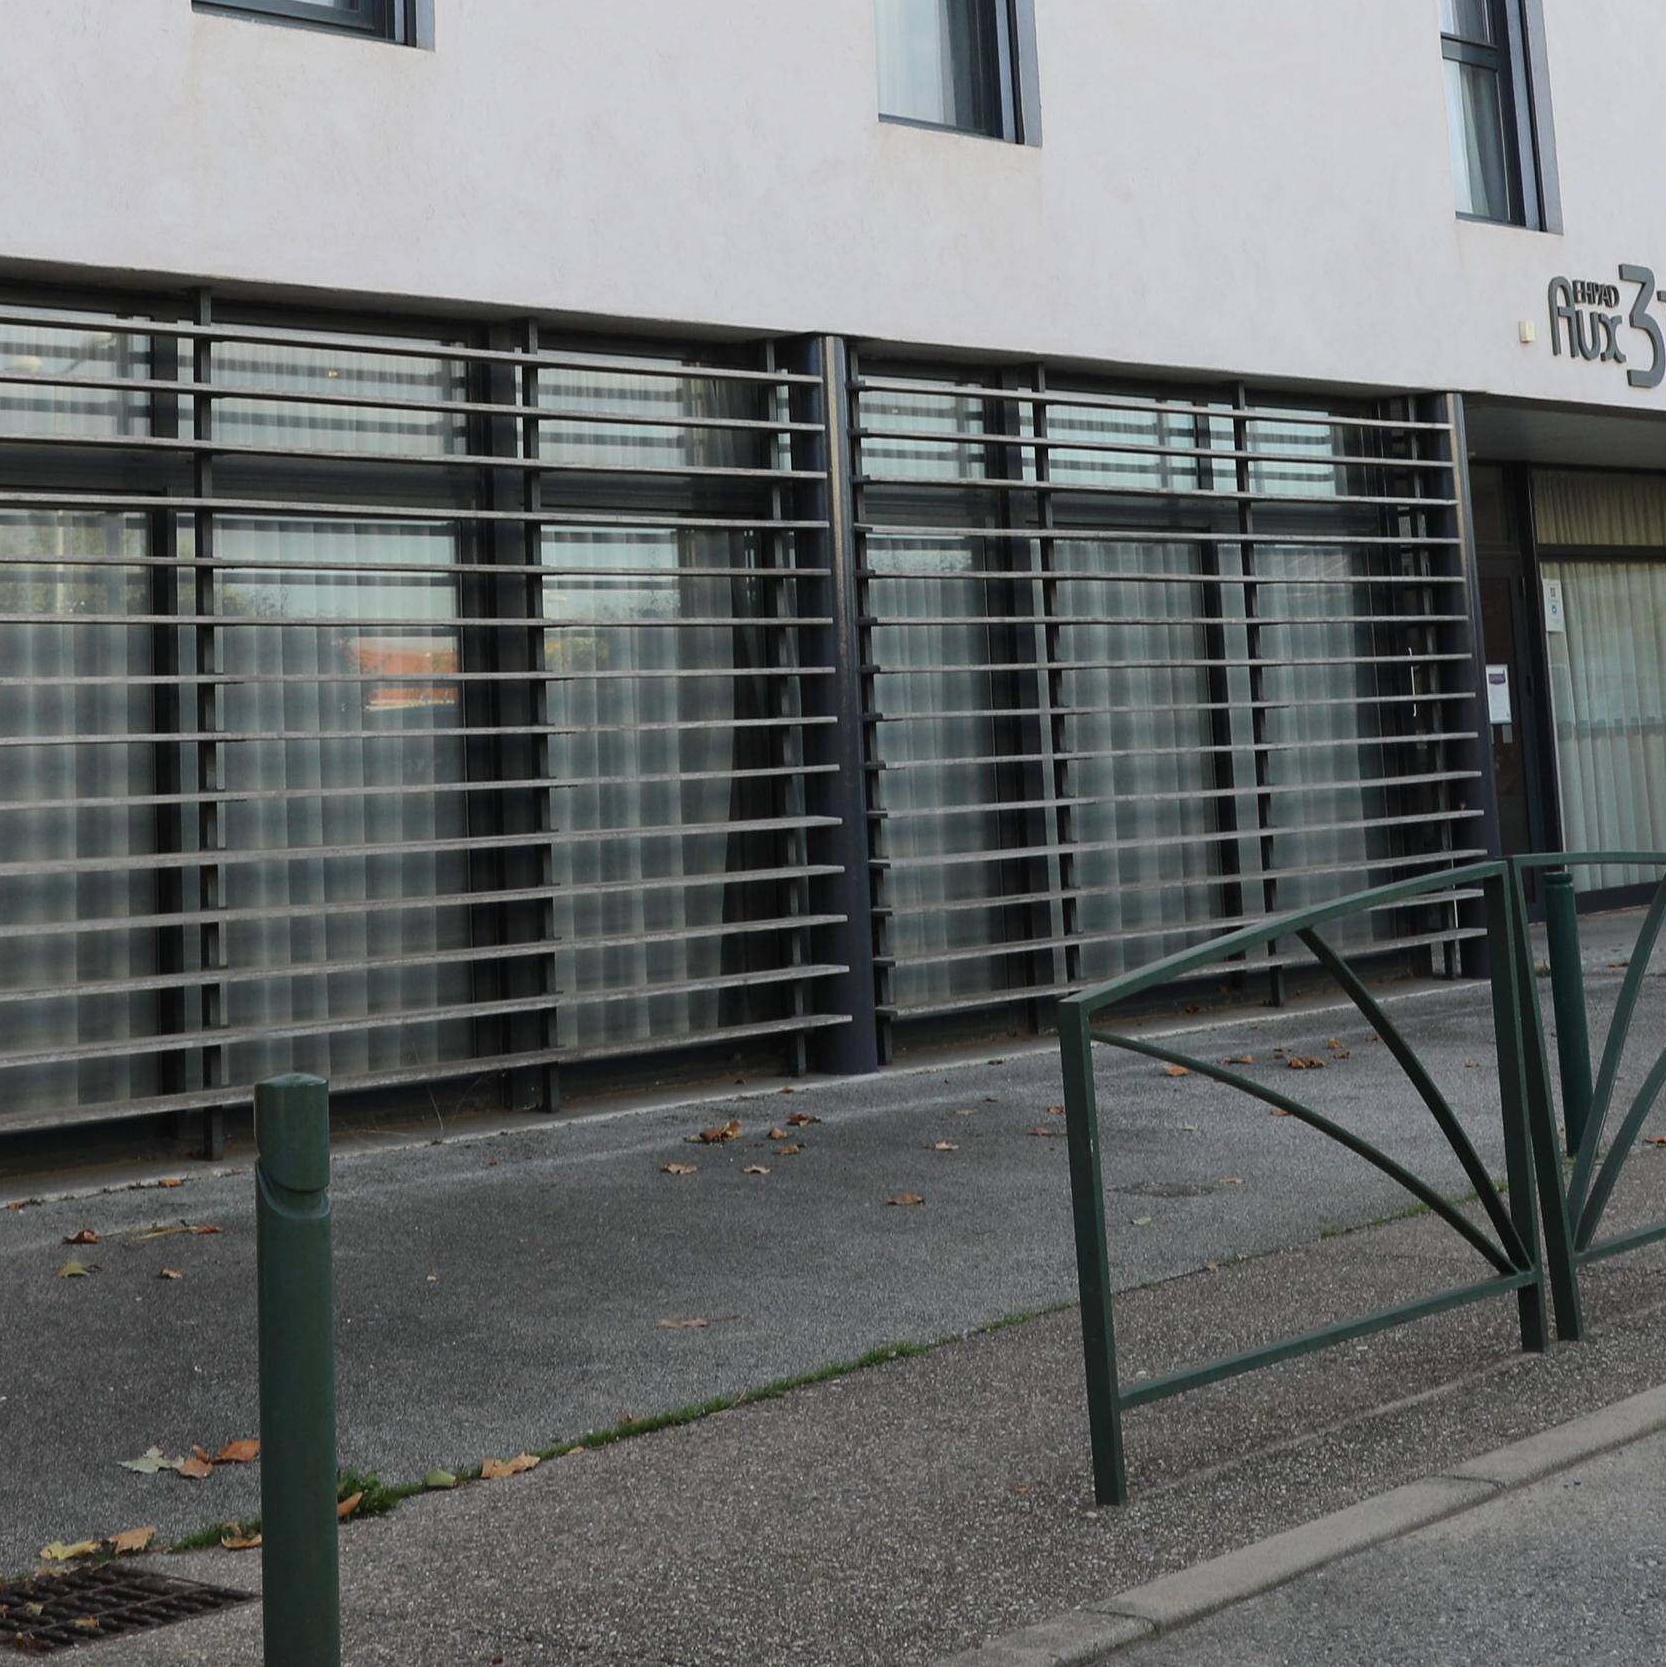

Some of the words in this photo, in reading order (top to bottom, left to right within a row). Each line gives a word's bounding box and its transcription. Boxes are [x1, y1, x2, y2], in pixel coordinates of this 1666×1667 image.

[1548, 276, 1626, 363] Aux
[1618, 263, 1666, 387] 3
[1572, 280, 1620, 308] EHPAD
